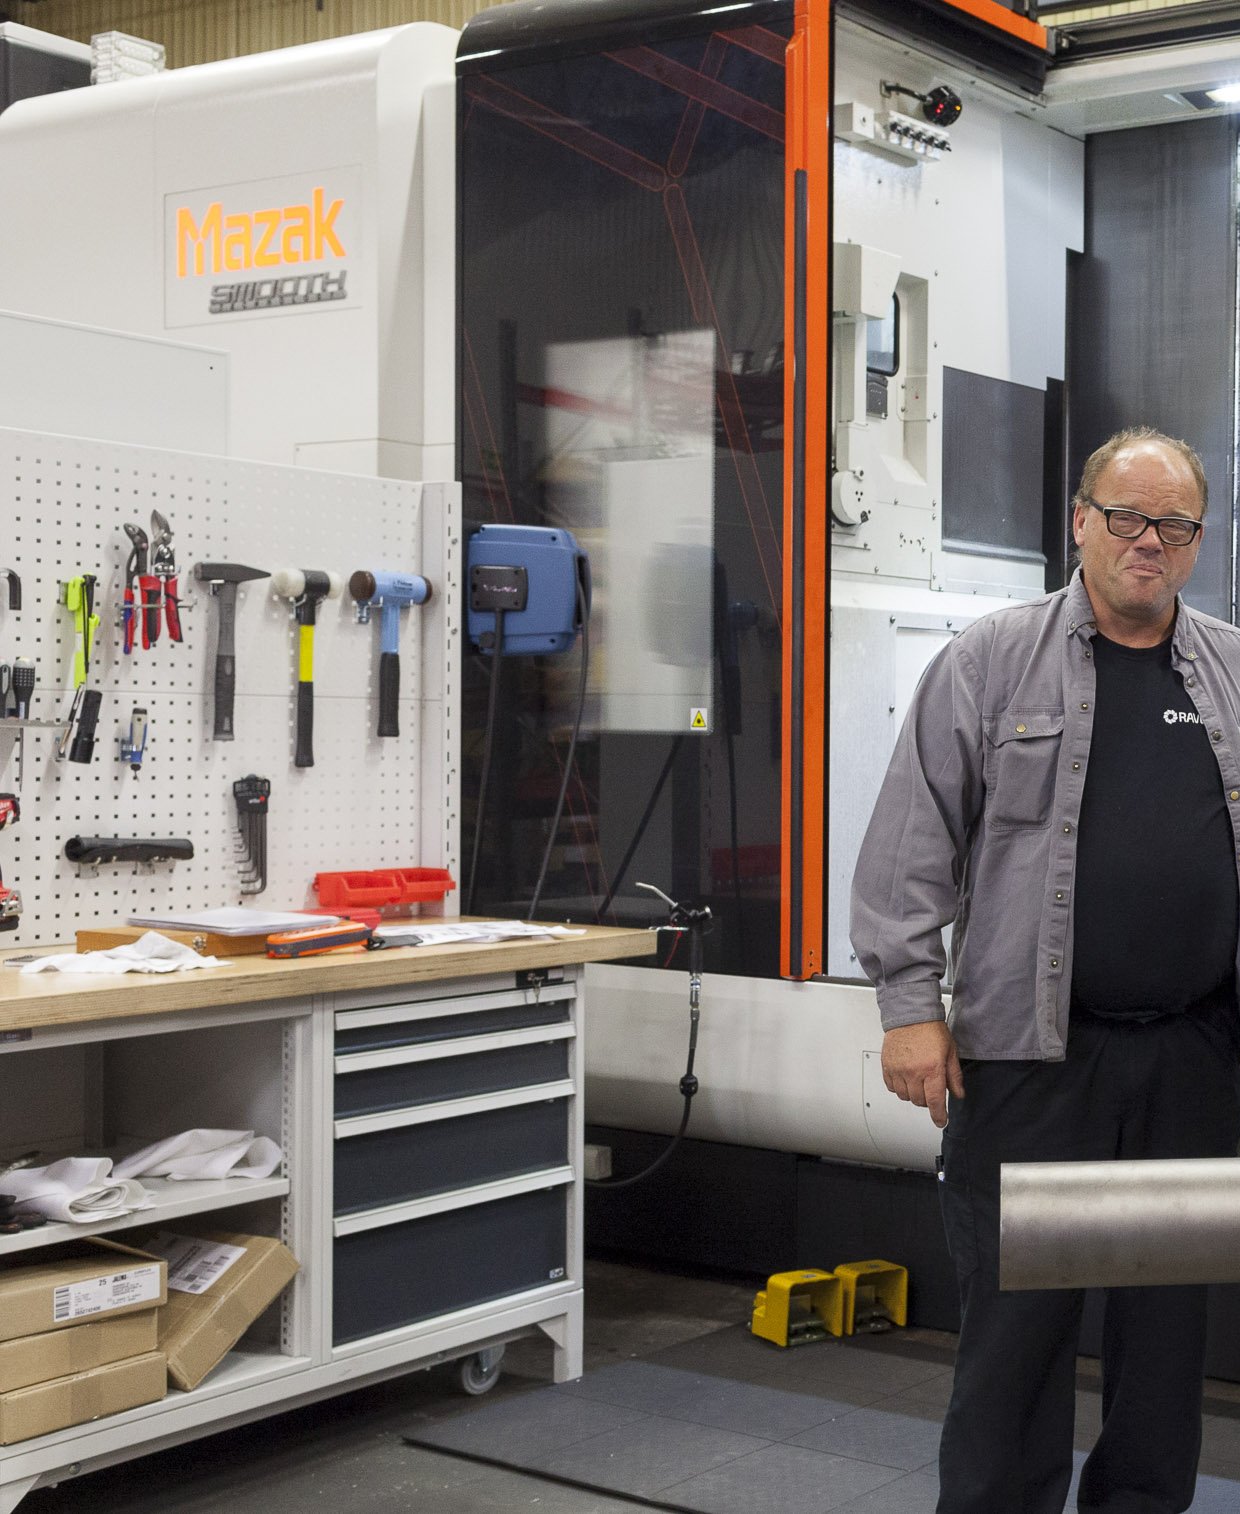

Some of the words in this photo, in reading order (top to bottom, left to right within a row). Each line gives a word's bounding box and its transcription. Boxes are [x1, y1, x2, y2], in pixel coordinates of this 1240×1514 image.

[177, 186, 347, 279] Mazak
[210, 270, 348, 305] SMOOTH
[1178, 711, 1204, 725] RAV
